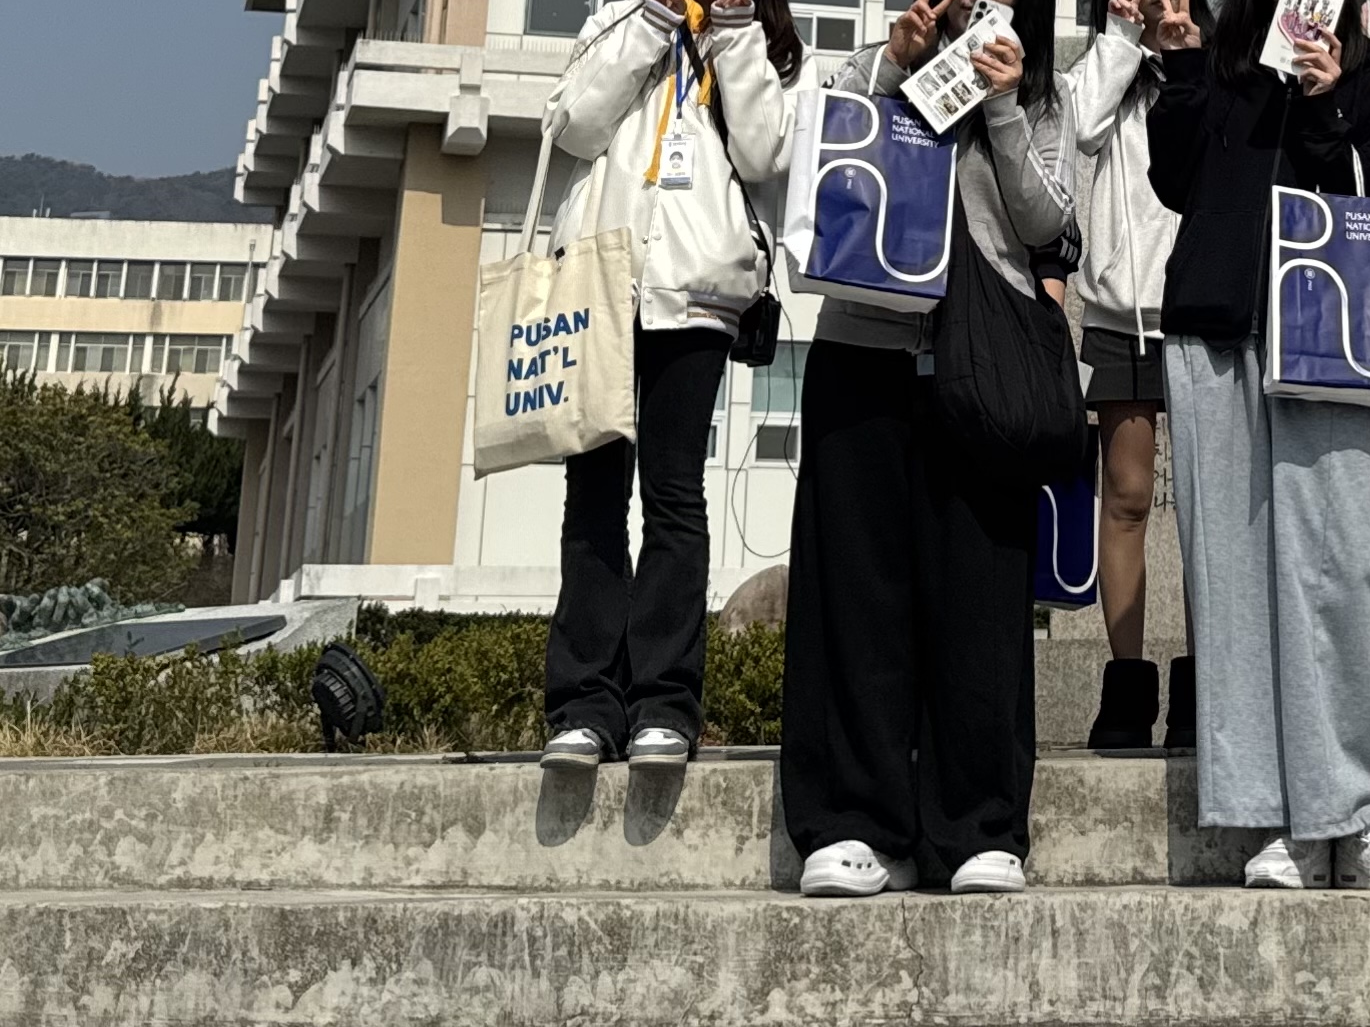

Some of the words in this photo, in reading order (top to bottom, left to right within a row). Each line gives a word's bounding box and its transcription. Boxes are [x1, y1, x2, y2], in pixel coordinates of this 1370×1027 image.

[891, 124, 935, 139] NATIONAL
[892, 114, 921, 127] PUSAN
[891, 133, 940, 149] UNIVERSITY
[510, 307, 590, 349] PUSAN
[507, 345, 578, 383] NAT'L
[505, 380, 570, 417] UNIV.
